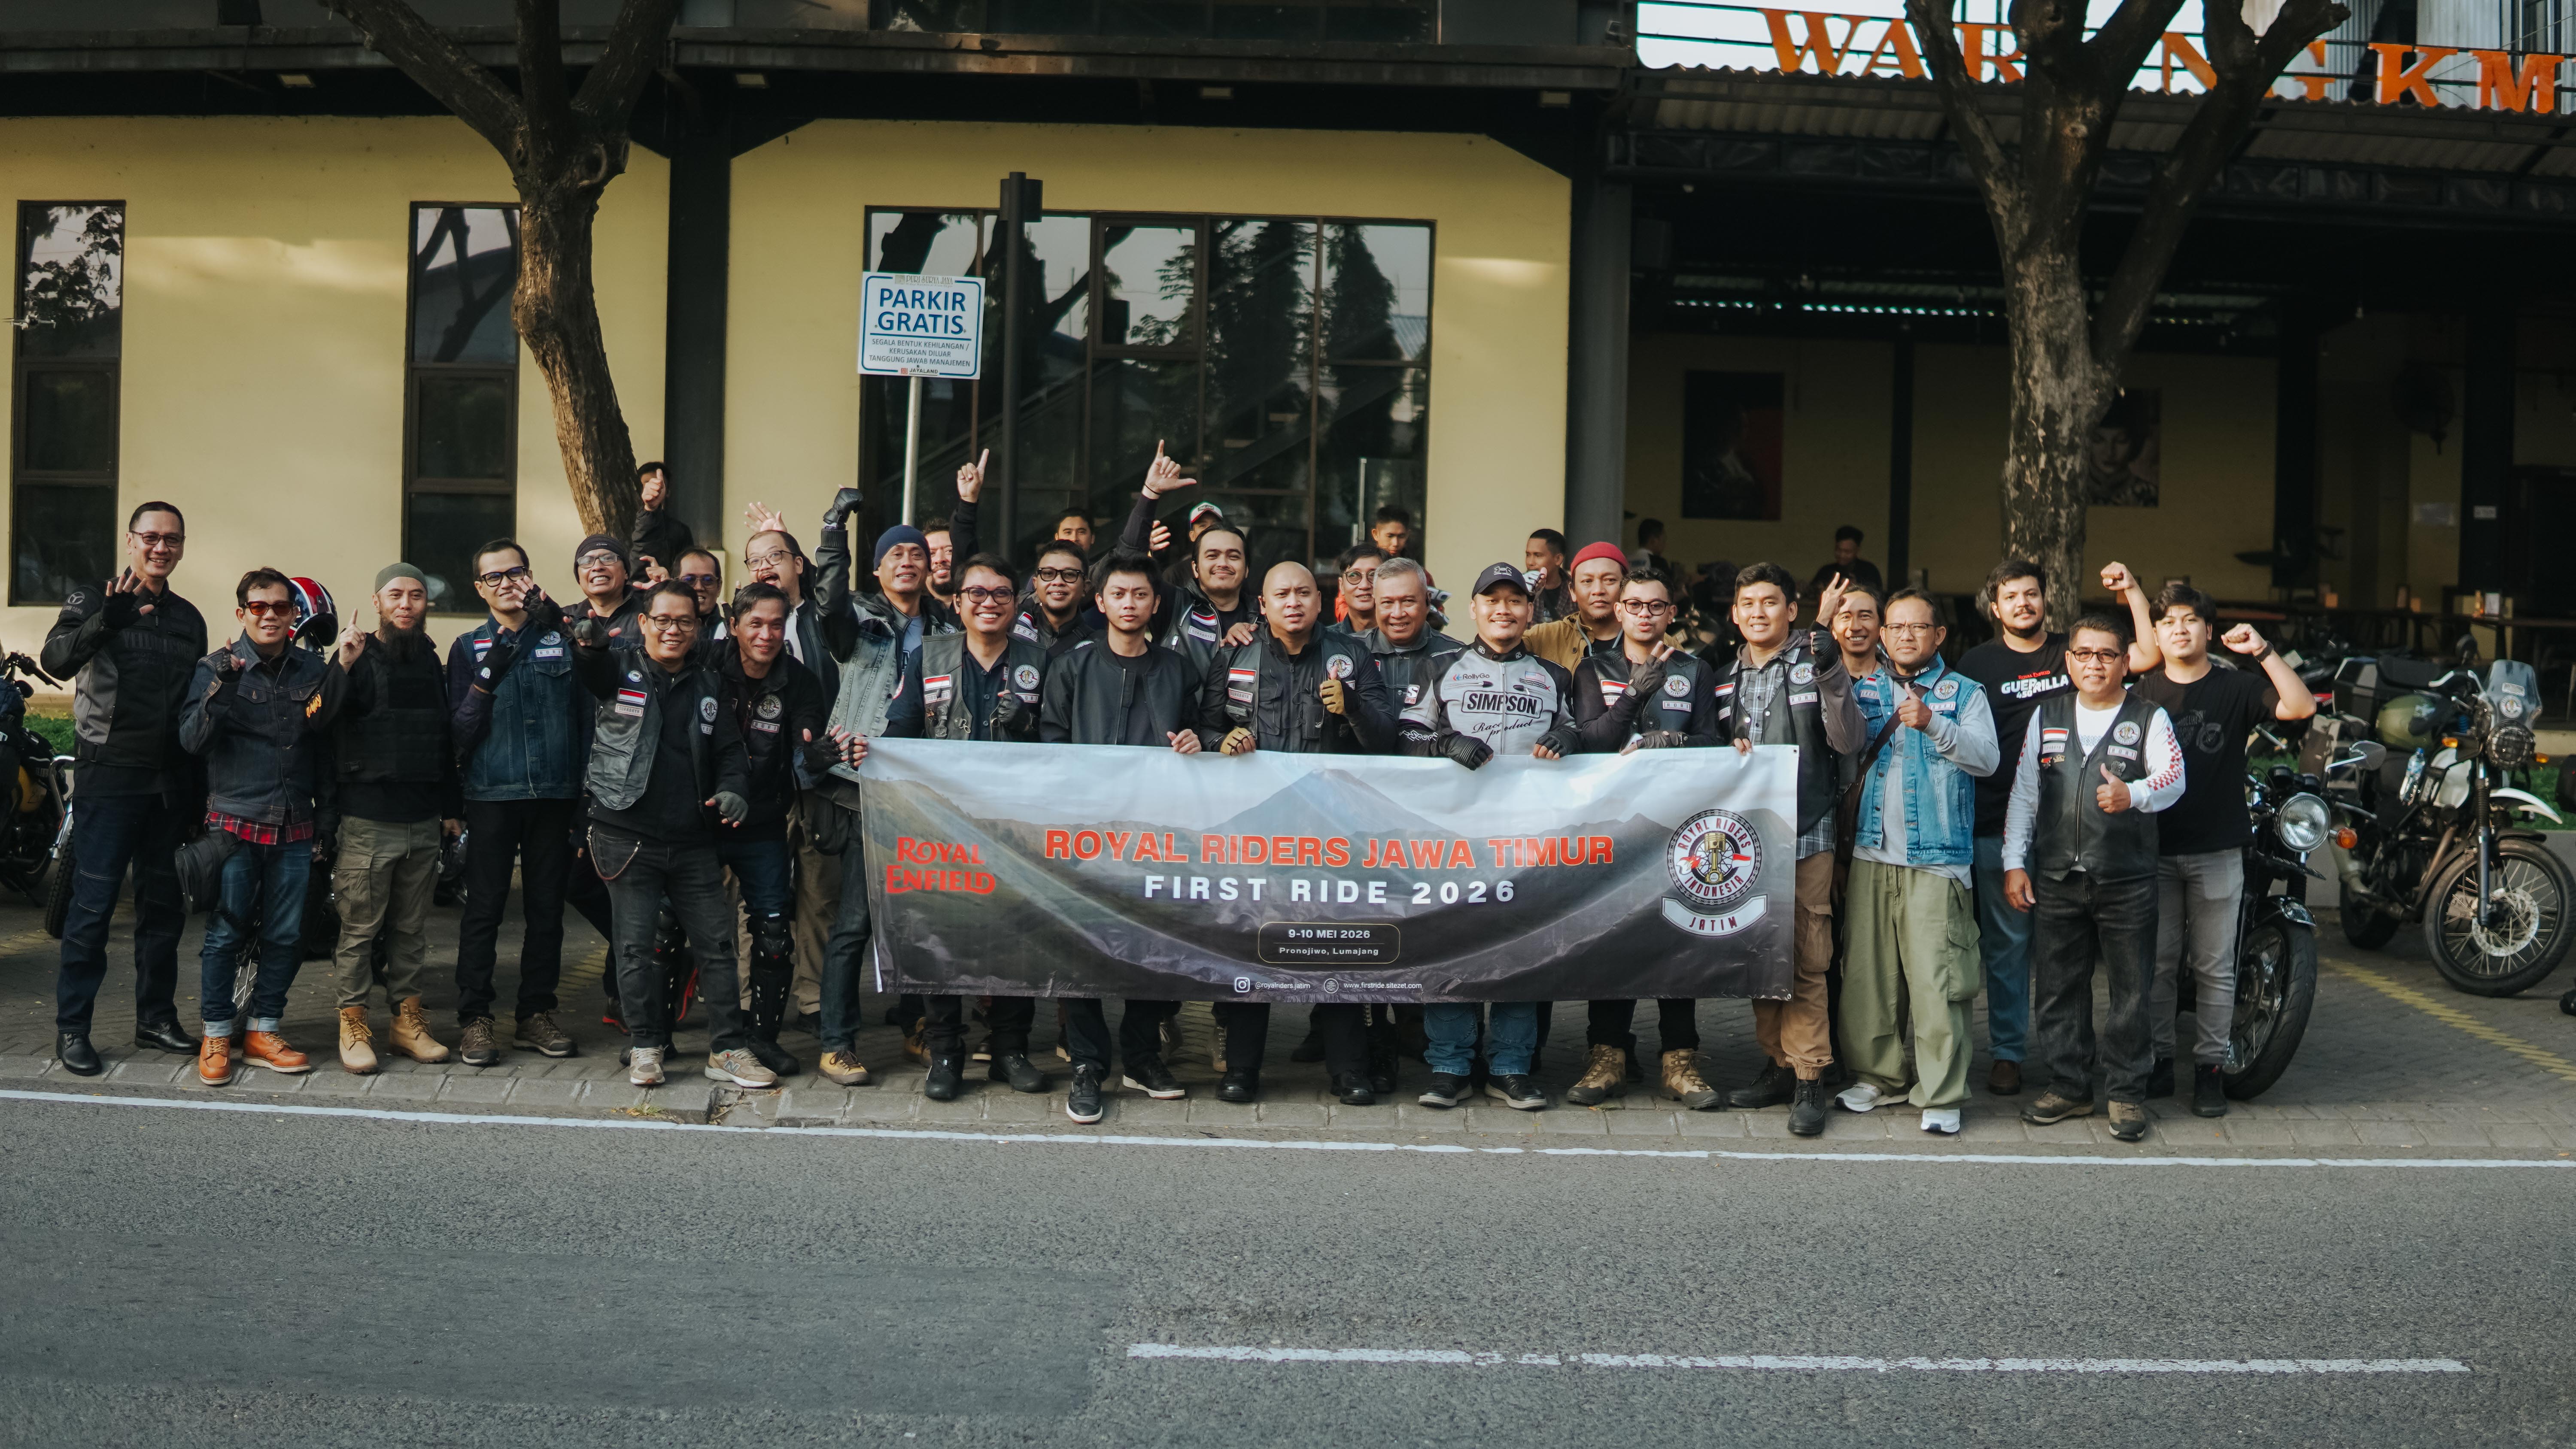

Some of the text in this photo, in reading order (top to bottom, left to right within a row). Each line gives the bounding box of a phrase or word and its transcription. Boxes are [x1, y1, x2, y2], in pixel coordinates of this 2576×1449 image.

[921, 276, 939, 284] SURYA
[880, 288, 966, 312] PARKIR
[878, 311, 963, 335] GRATIS
[889, 348, 927, 356] KERUSAKAN
[924, 342, 964, 350] KEHILANGAN
[869, 355, 905, 363] TANGGUNG
[930, 358, 971, 367] MANAJEMEN
[1017, 627, 1036, 639] RORI
[1192, 629, 1212, 639] SURABAYA
[2001, 674, 2069, 694] GUERRILLA
[1229, 691, 1249, 699] SURABAYA
[2016, 690, 2033, 699] 450
[1467, 693, 1537, 715] SIMPSON
[618, 706, 641, 715] SURABAYA
[2111, 748, 2133, 757] RORI
[1677, 818, 1751, 851] ROYAL RIDERS
[897, 837, 985, 865] ROYAL
[1045, 829, 1614, 869] ROYAL RIDERS JAWA TIMUR
[886, 864, 996, 895] ENFIELD
[1145, 875, 1514, 904] FIRST RIDE 2026
[1685, 875, 1744, 897] INDONESIA
[1689, 916, 1738, 931] JATIM
[1288, 929, 1370, 939] 9-10 MEI 2026
[1279, 947, 1379, 956] Pronojiwo, Lumajang
